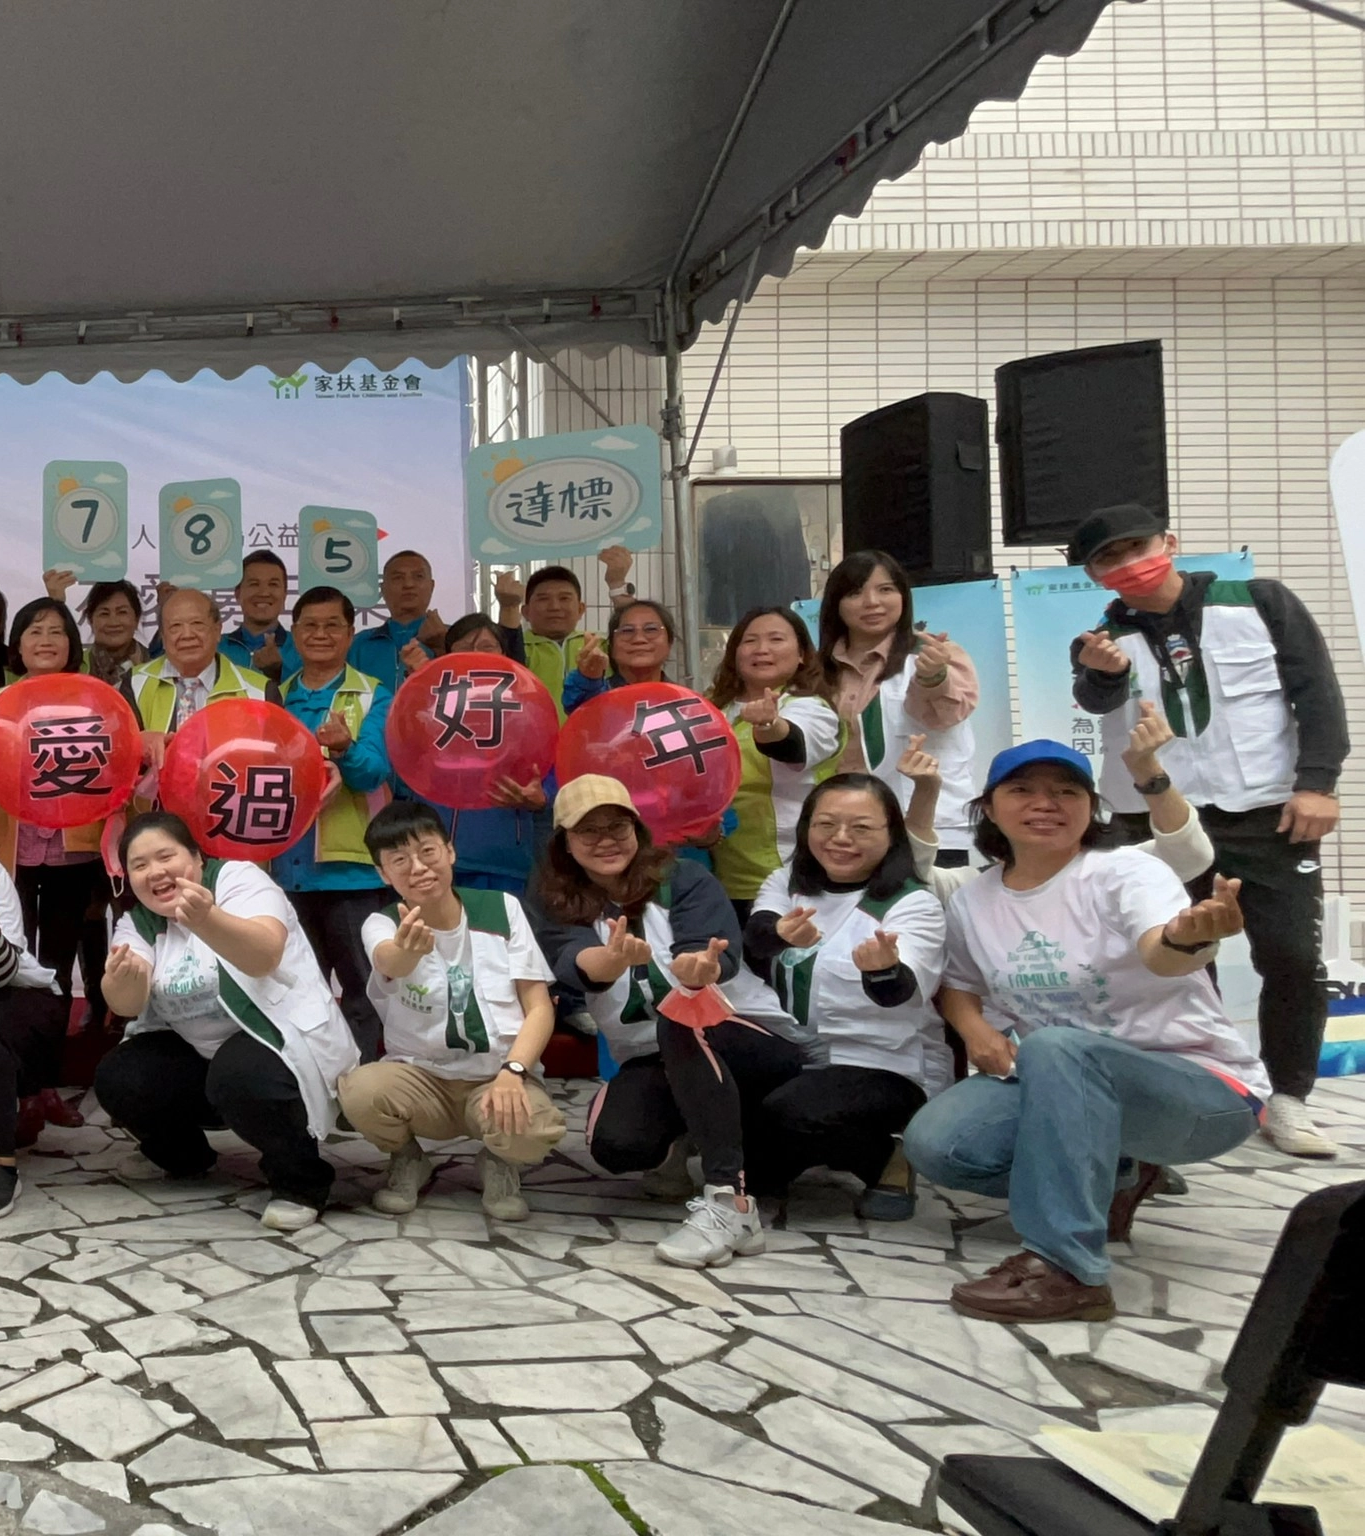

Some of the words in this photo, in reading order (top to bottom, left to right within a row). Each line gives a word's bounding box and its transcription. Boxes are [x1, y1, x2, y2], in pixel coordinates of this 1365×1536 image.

[314, 374, 422, 392] 家扶基金會
[70, 499, 99, 544] 7
[505, 476, 613, 528] 達標
[185, 513, 216, 556] 8
[324, 537, 353, 574] 5
[431, 668, 524, 752] 好
[630, 696, 729, 776] 年
[29, 715, 113, 800] 愛
[206, 761, 297, 847] 過
